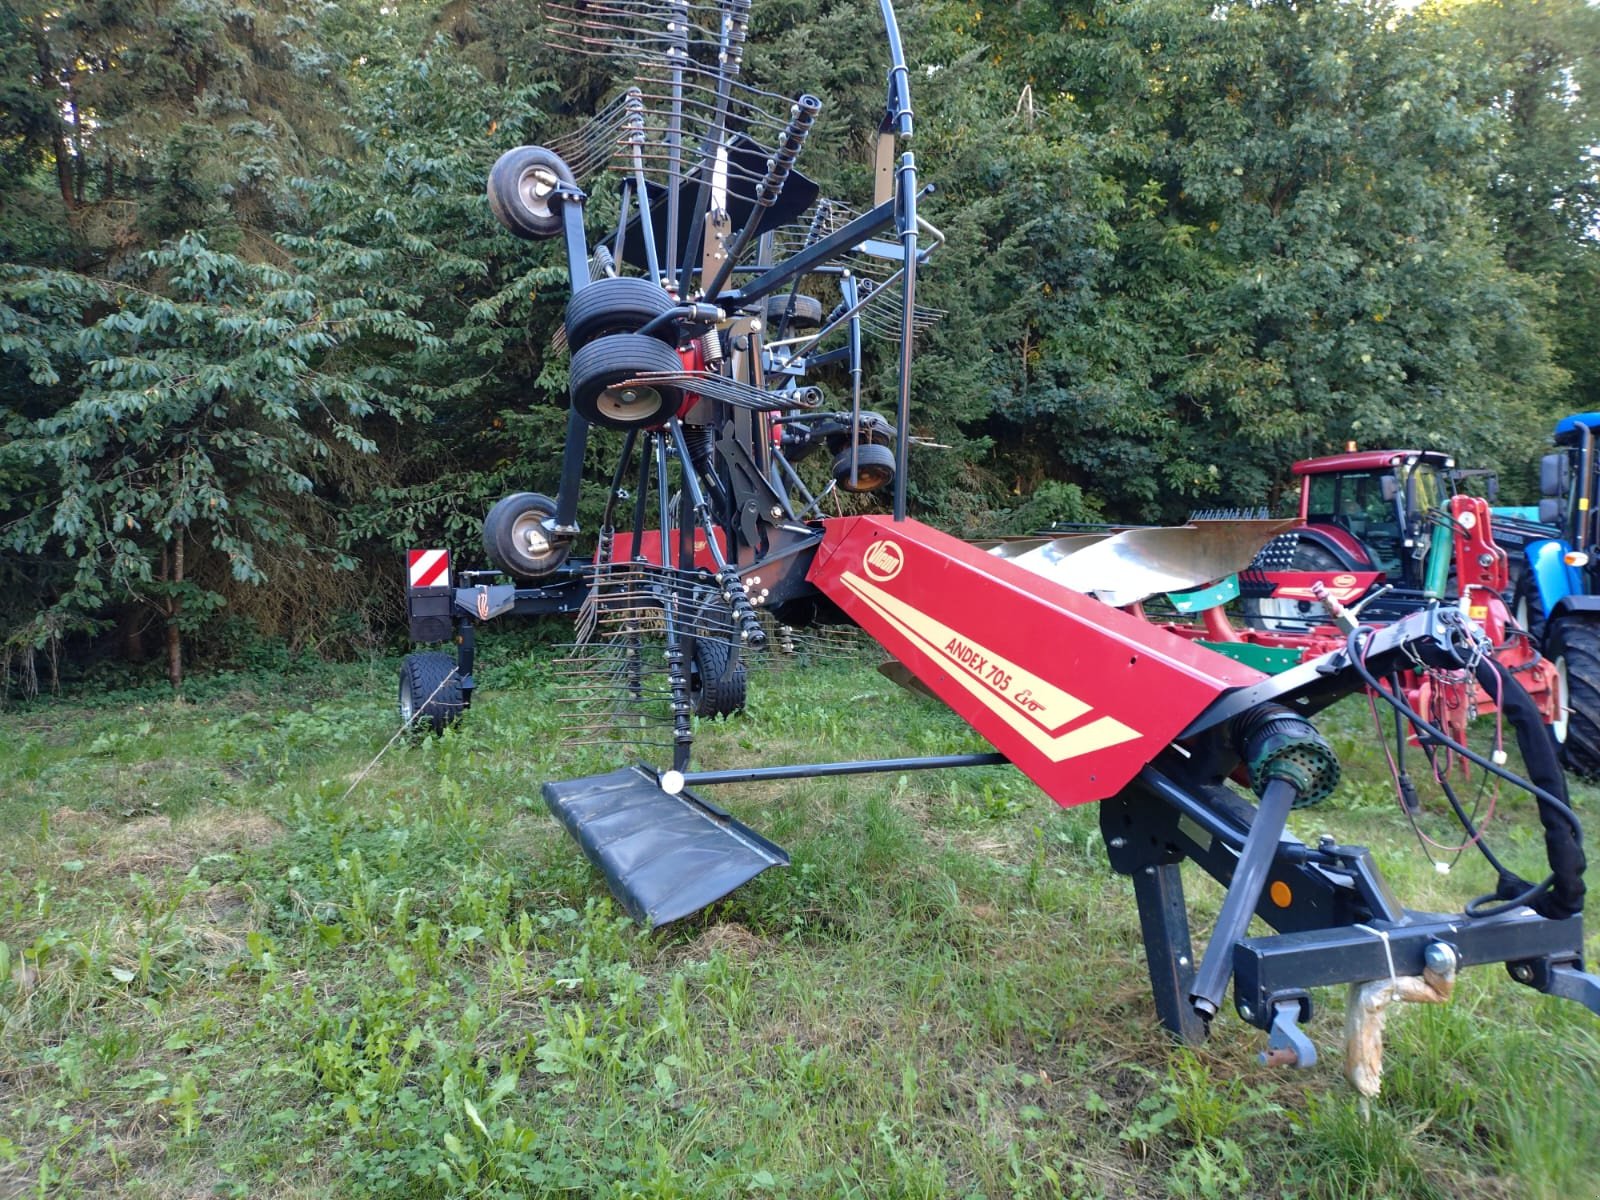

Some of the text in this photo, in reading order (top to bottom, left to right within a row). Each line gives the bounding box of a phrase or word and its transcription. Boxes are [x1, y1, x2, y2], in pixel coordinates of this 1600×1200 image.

[945, 638, 1047, 711] ANDEX 705 Evo
